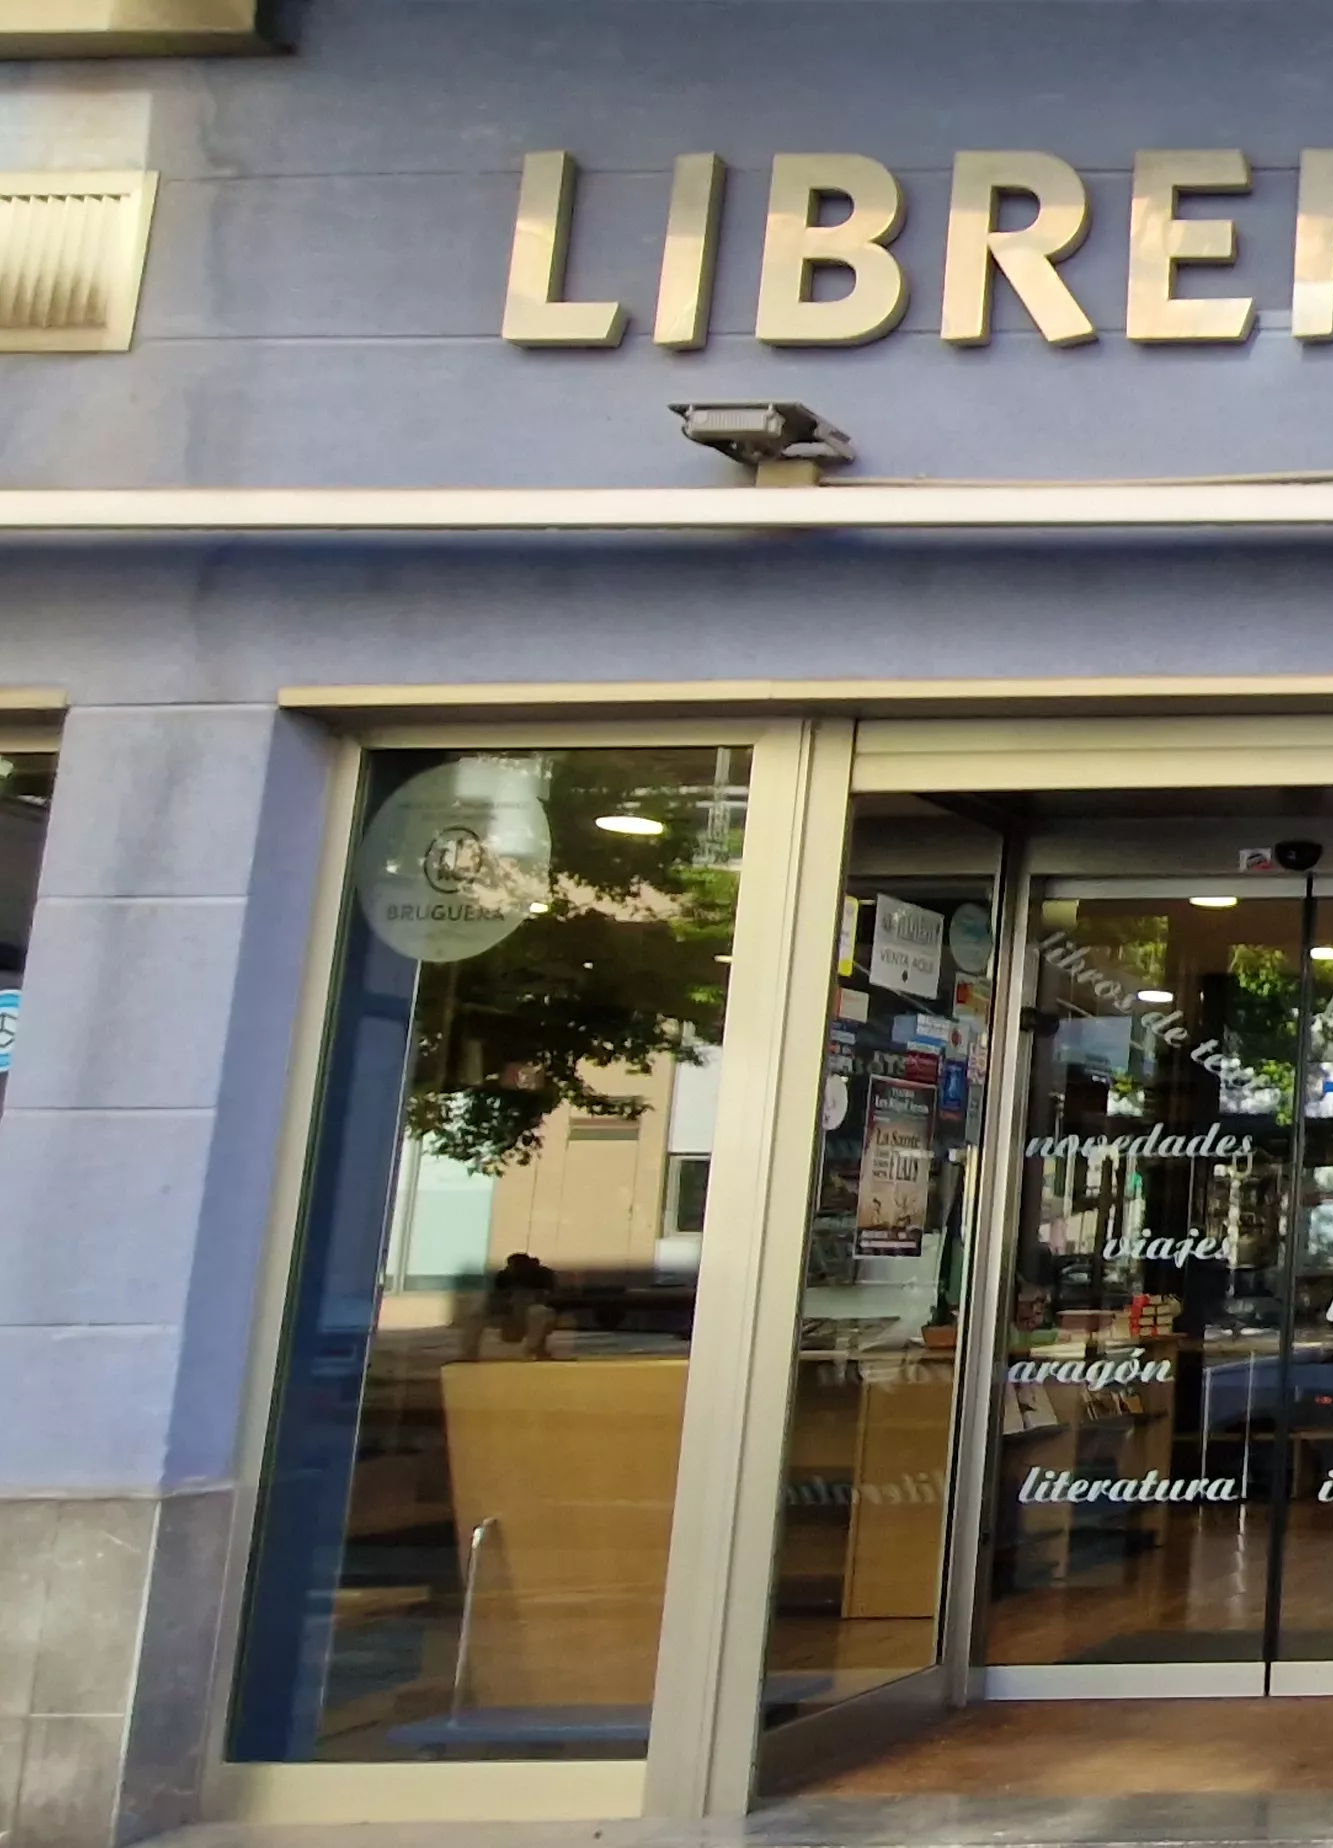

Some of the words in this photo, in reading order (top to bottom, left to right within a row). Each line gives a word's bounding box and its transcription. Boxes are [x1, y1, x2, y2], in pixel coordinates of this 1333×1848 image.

[386, 904, 506, 923] BRUGUERA
[1040, 931, 1136, 1013] libros
[1026, 1122, 1256, 1158] novedades
[1103, 1228, 1232, 1268] viajes
[1008, 1348, 1176, 1391] aragón
[1018, 1466, 1241, 1505] literatura
